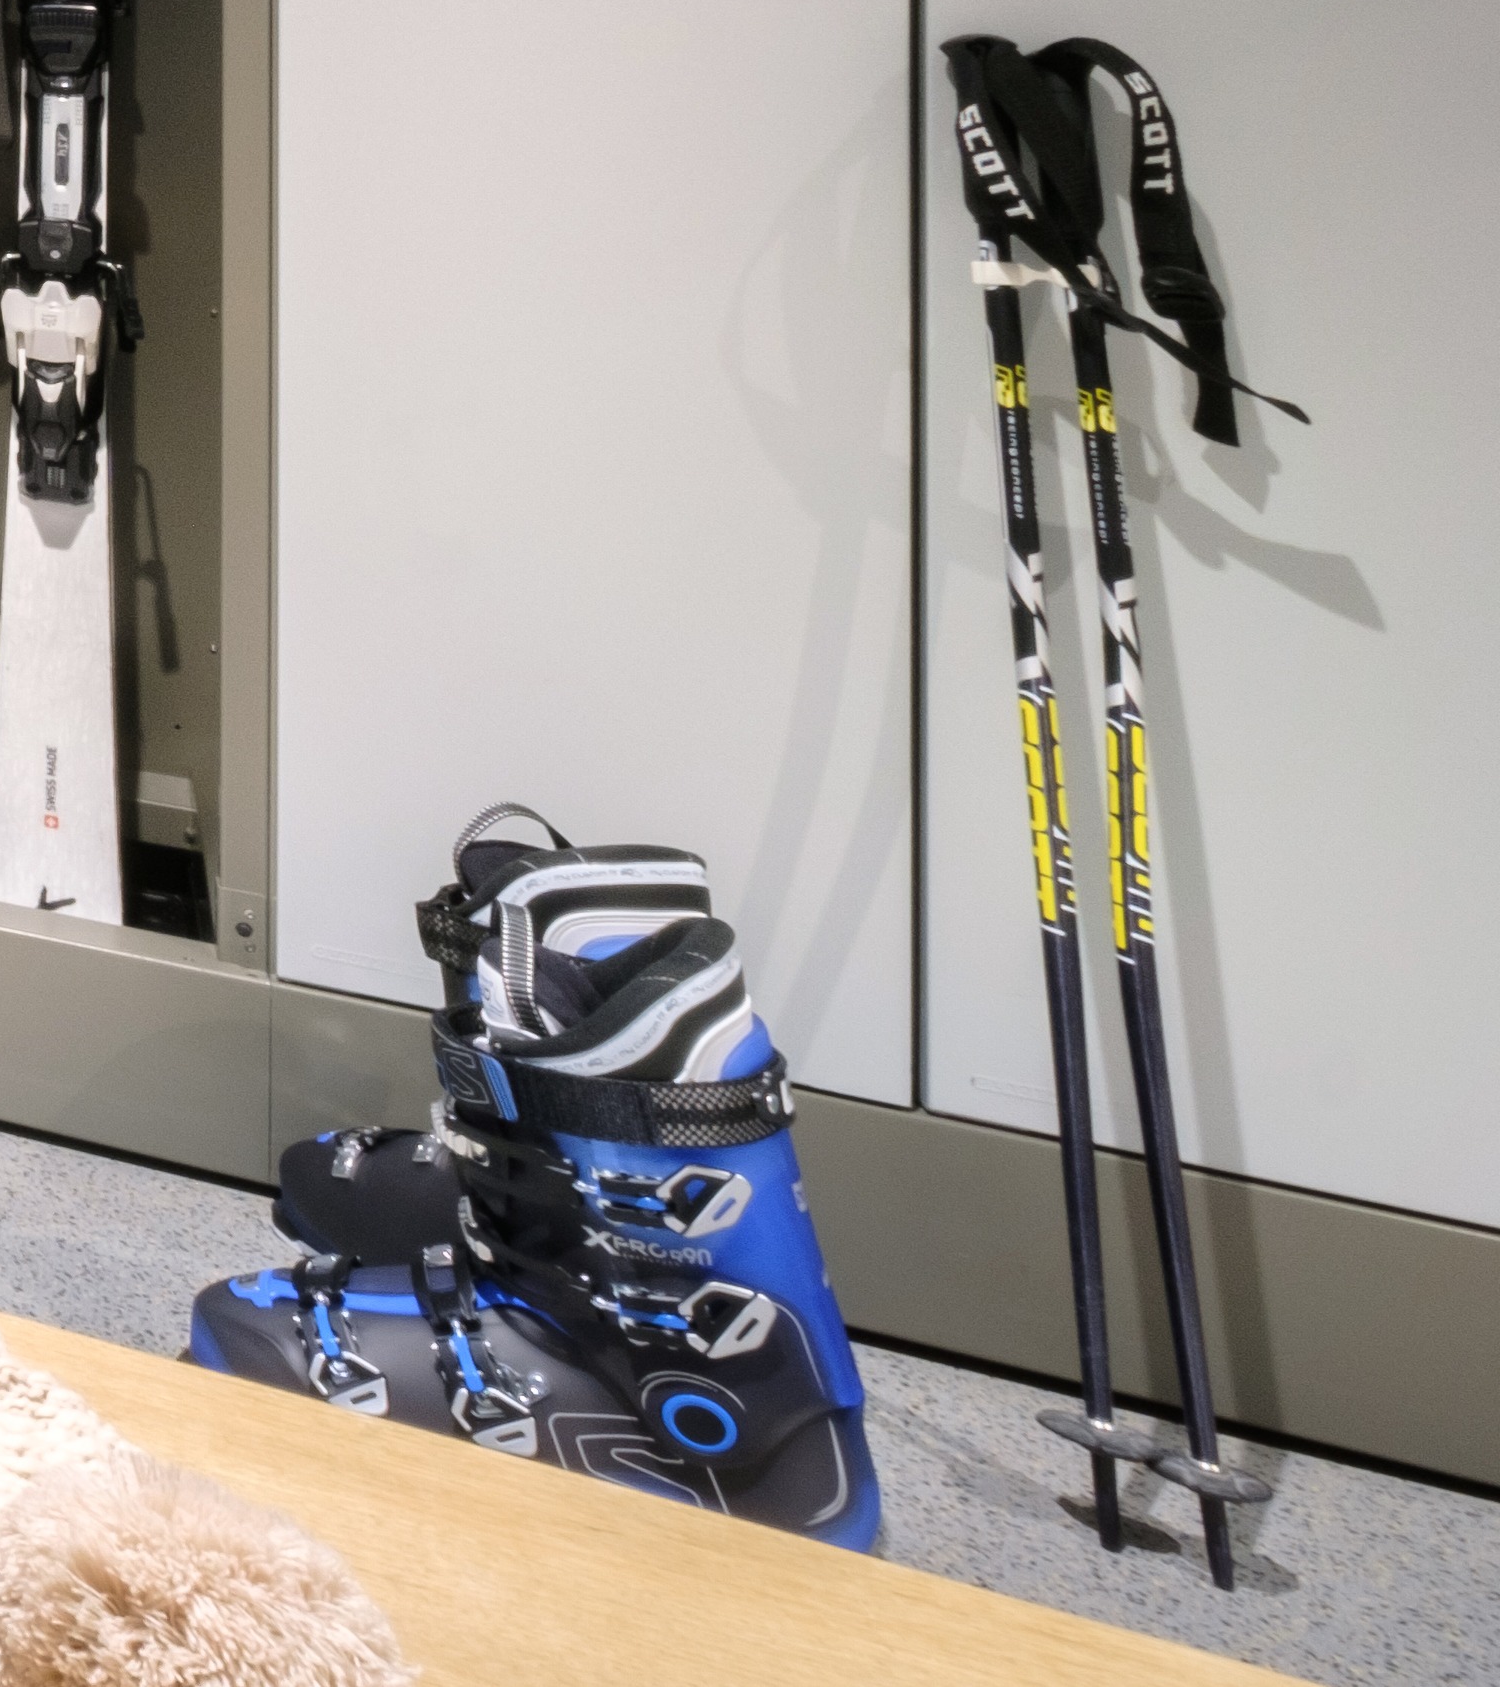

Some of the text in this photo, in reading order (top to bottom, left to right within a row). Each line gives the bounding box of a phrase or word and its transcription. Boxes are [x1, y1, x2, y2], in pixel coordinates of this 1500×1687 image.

[957, 103, 1035, 221] SCOTT
[1122, 70, 1175, 195] SCOTT
[45, 745, 57, 777] MADE
